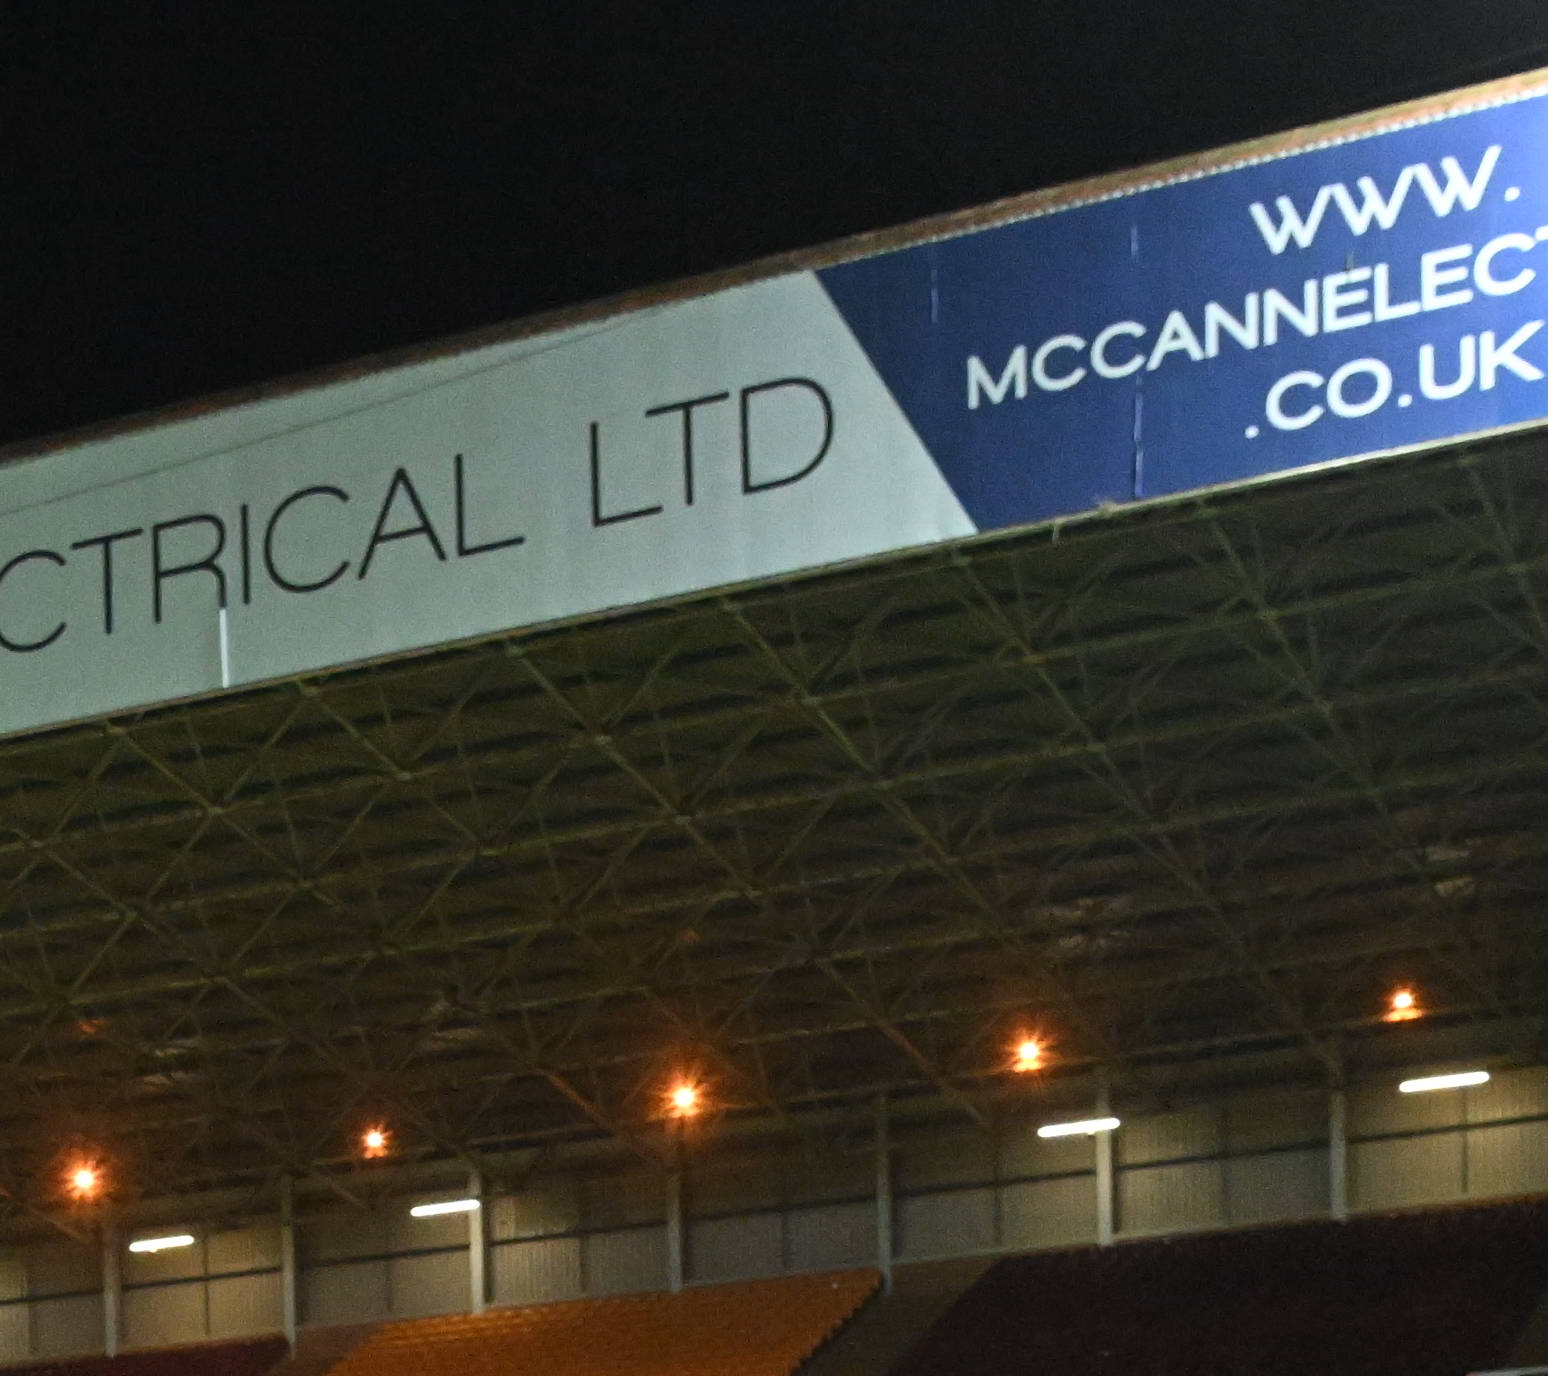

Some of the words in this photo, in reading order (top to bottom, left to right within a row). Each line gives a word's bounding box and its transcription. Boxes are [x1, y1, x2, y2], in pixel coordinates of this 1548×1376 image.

[1249, 144, 1521, 257] WWW.
[1245, 321, 1545, 439] .CO.UK
[590, 375, 836, 530] LTD
